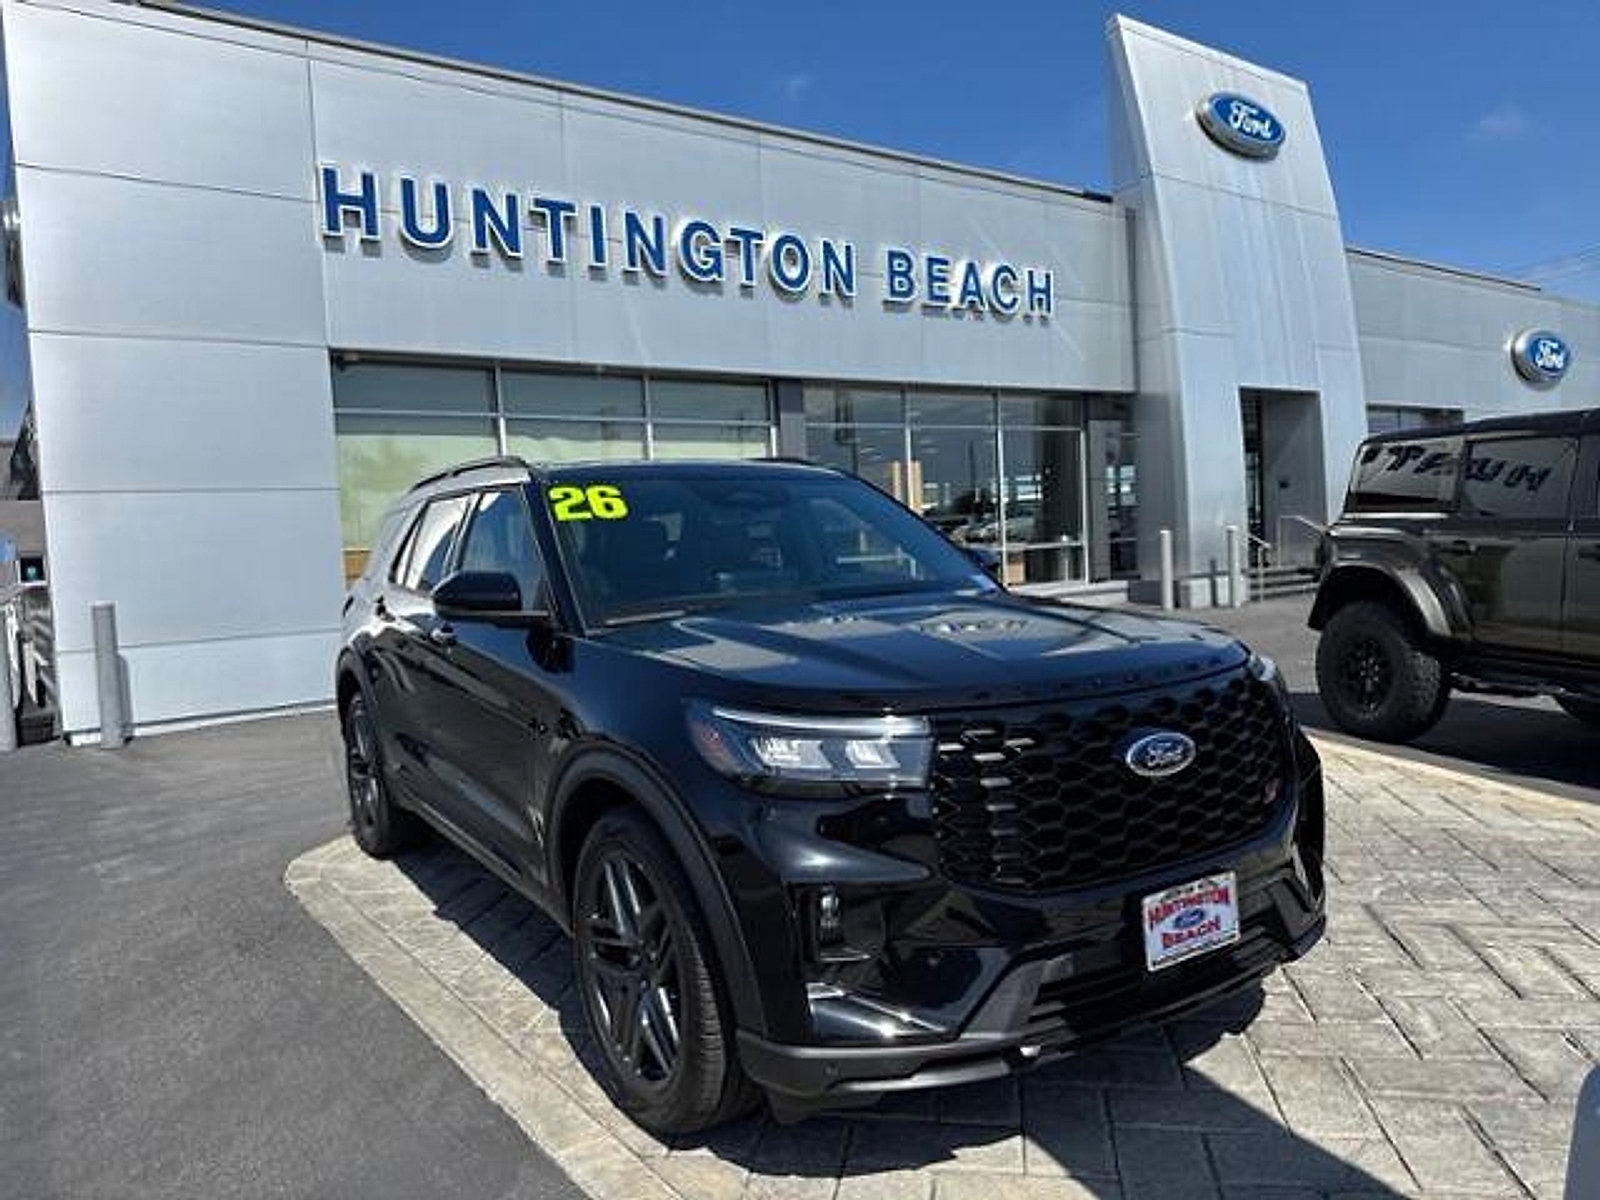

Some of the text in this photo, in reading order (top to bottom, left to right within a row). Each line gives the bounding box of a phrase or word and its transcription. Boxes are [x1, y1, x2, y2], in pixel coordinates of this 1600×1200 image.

[1228, 100, 1273, 139] Ford
[321, 165, 1054, 315] HUNTINGTON BEACH
[1534, 339, 1565, 369] Ford
[549, 485, 628, 521] 26
[1145, 741, 1184, 767] Ford
[1161, 916, 1221, 949] BEACH
